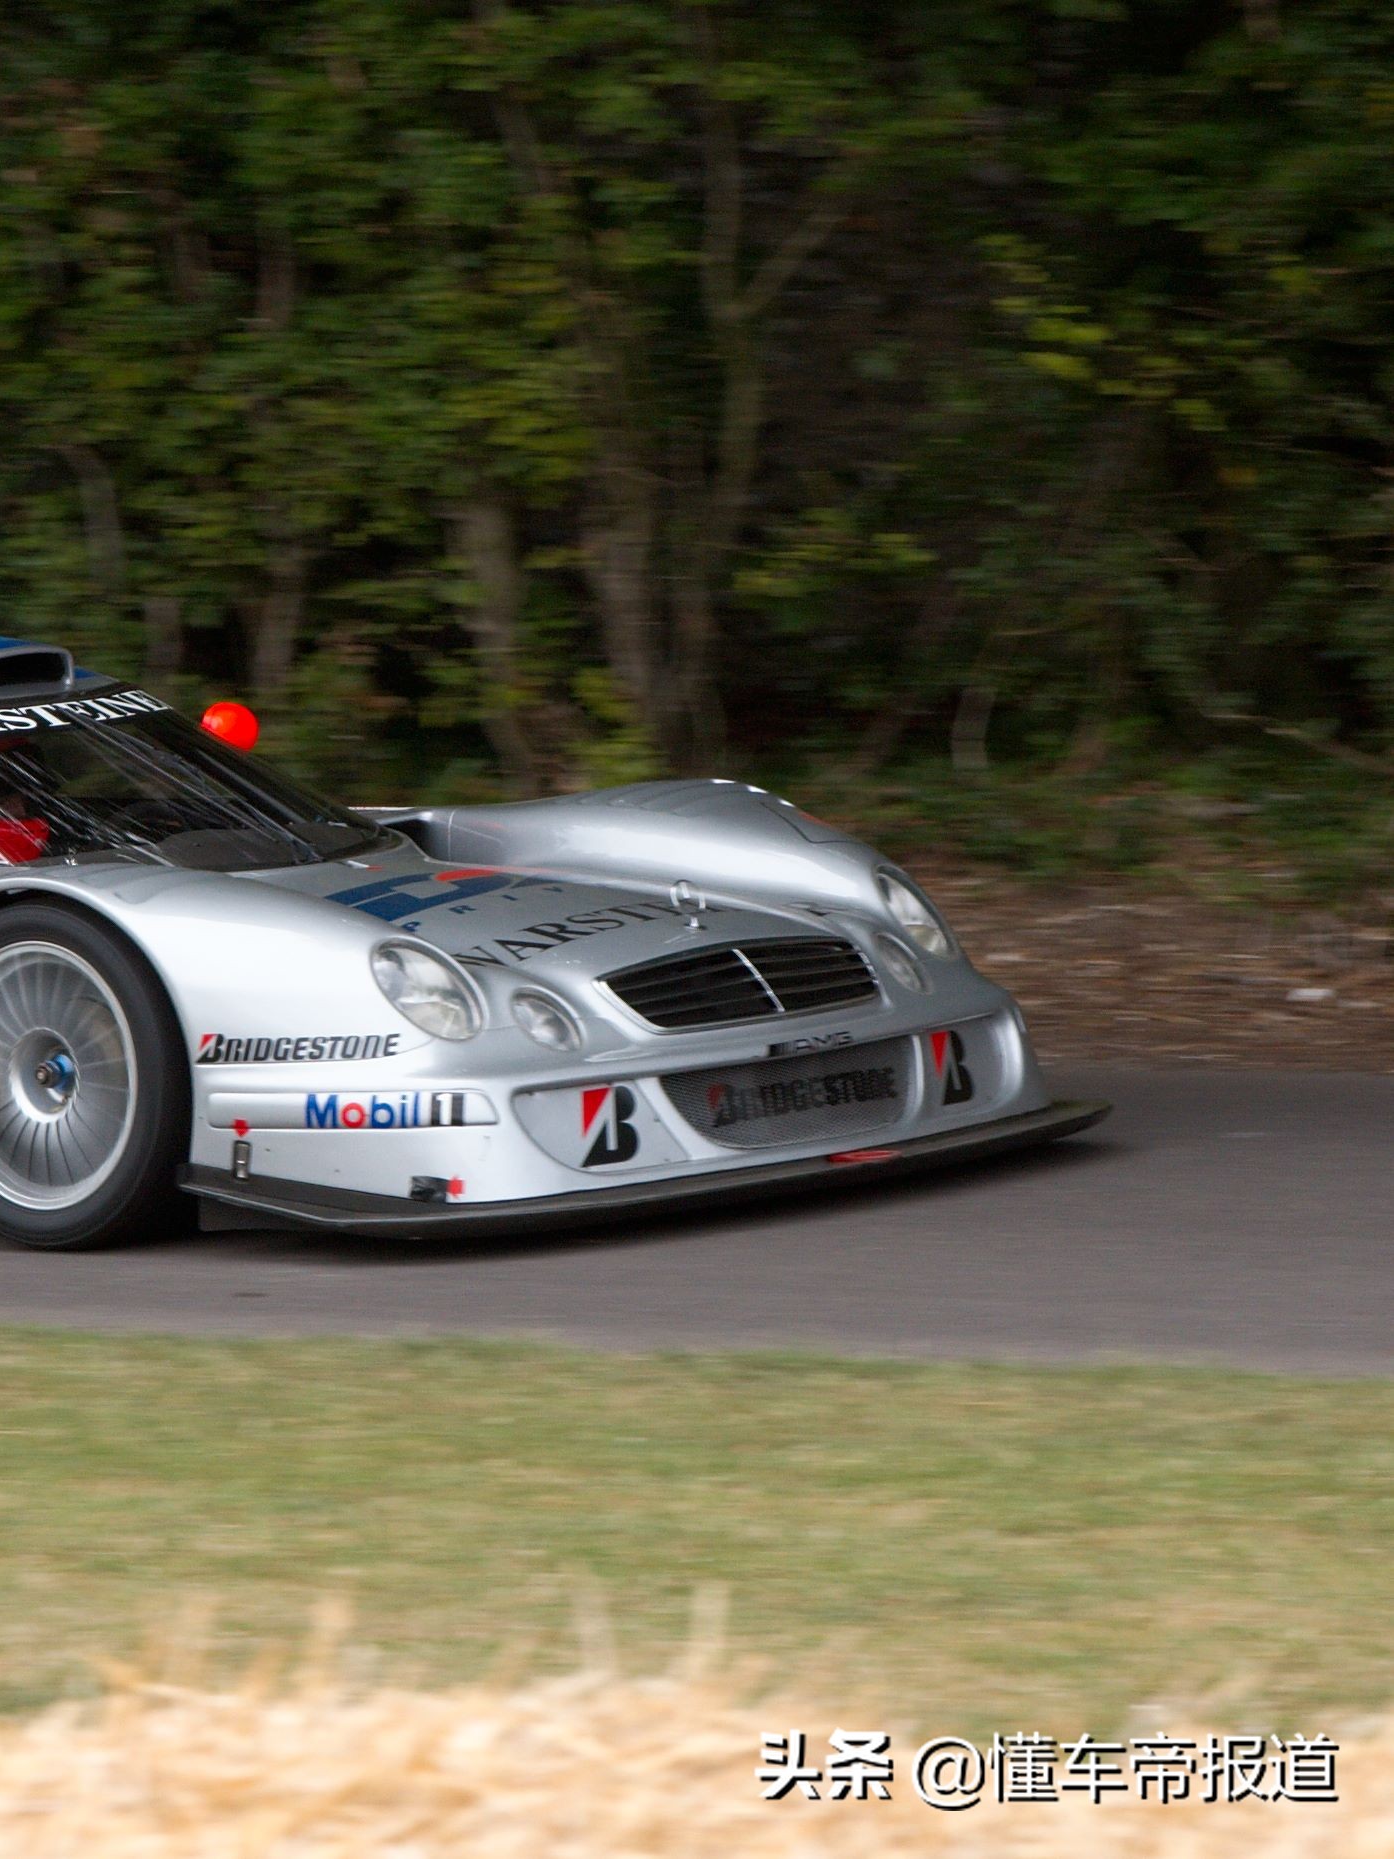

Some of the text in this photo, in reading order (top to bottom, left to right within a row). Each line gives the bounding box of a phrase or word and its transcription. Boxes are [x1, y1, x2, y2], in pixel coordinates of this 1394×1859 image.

[195, 1034, 401, 1063] BRIDGESTONE
[795, 1031, 854, 1051] AMG
[305, 1091, 421, 1129] Mobil
